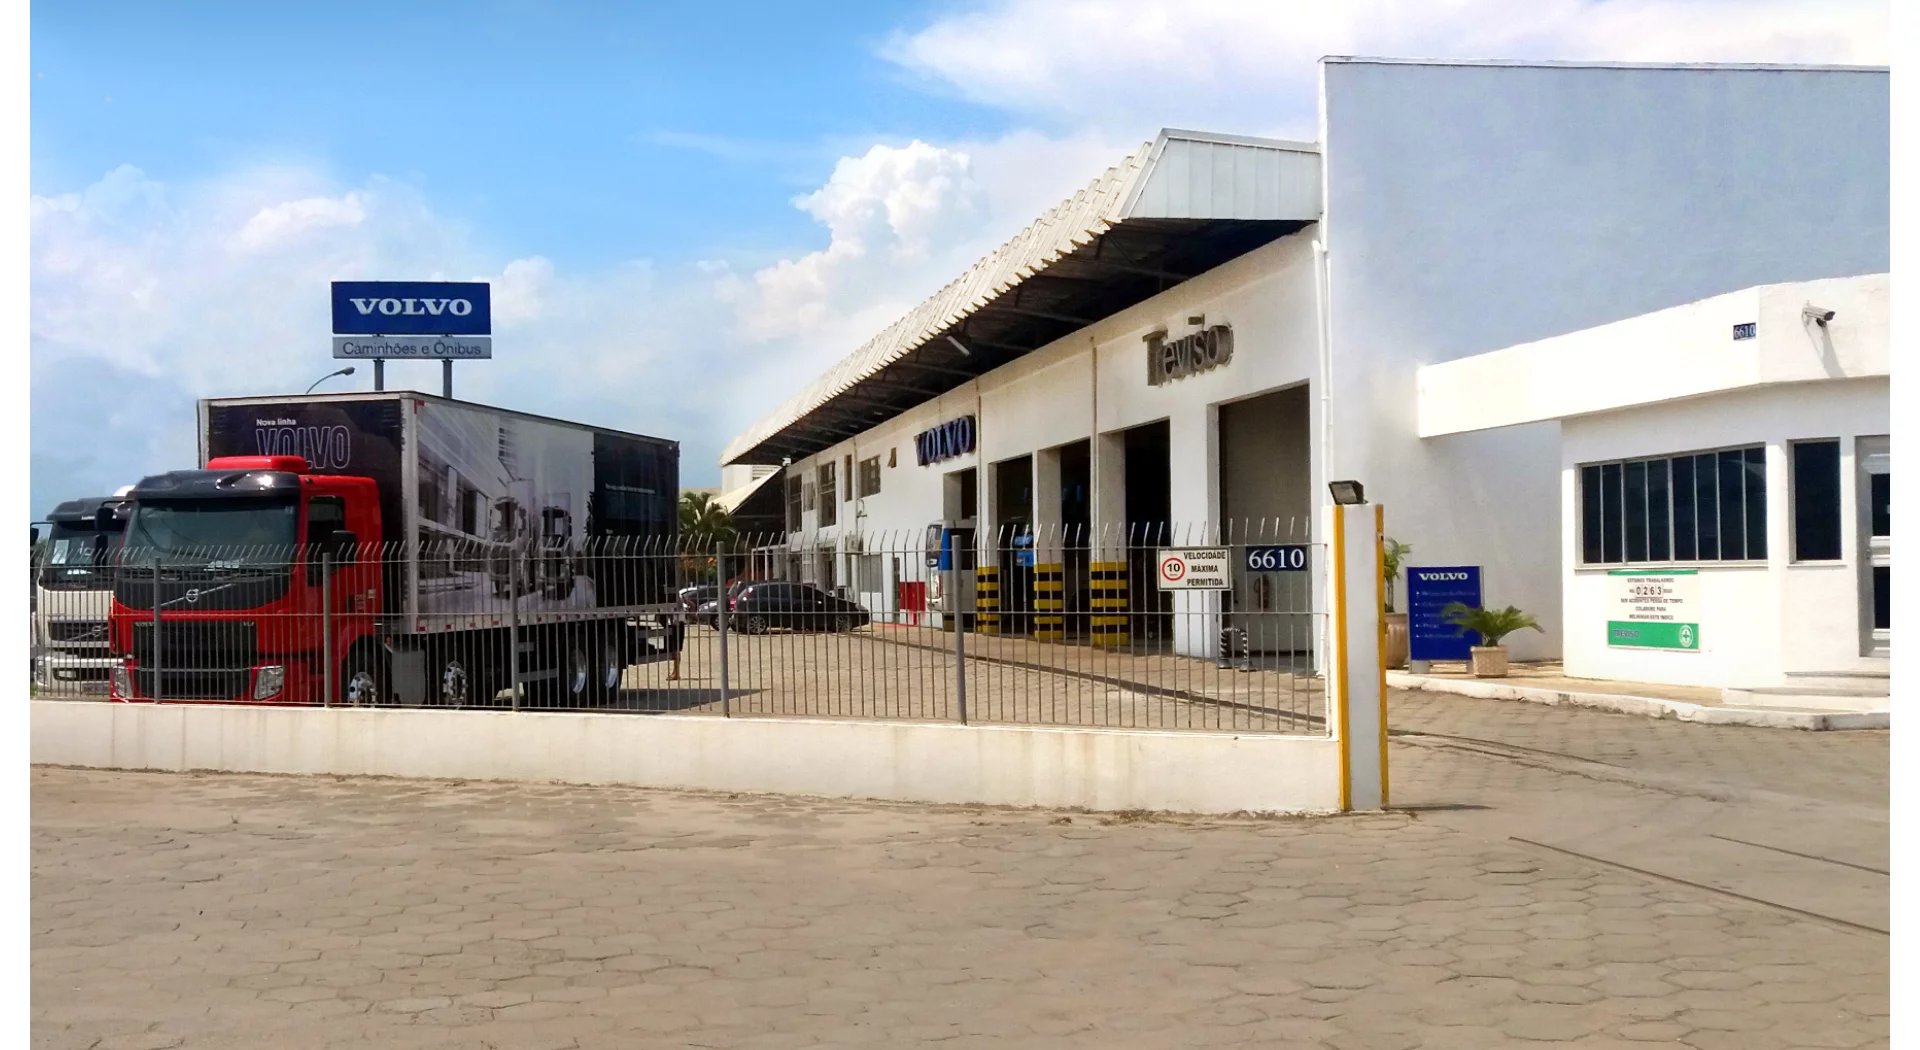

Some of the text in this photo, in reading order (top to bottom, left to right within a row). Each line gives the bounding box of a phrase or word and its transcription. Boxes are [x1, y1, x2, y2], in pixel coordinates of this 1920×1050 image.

[349, 298, 472, 316] VOLVO
[1734, 324, 1756, 338] 6610
[342, 340, 481, 355] Caminhões e Ônibus
[1142, 316, 1231, 386] Treviso
[277, 418, 296, 426] linha
[913, 415, 972, 467] VOLVO
[1184, 551, 1226, 560] VELOCIDADE
[1249, 548, 1305, 569] 6610
[1167, 563, 1181, 573] 10
[1187, 578, 1224, 586] PERMITIDA
[1418, 572, 1468, 581] VOLVO
[1636, 586, 1662, 596] 0263
